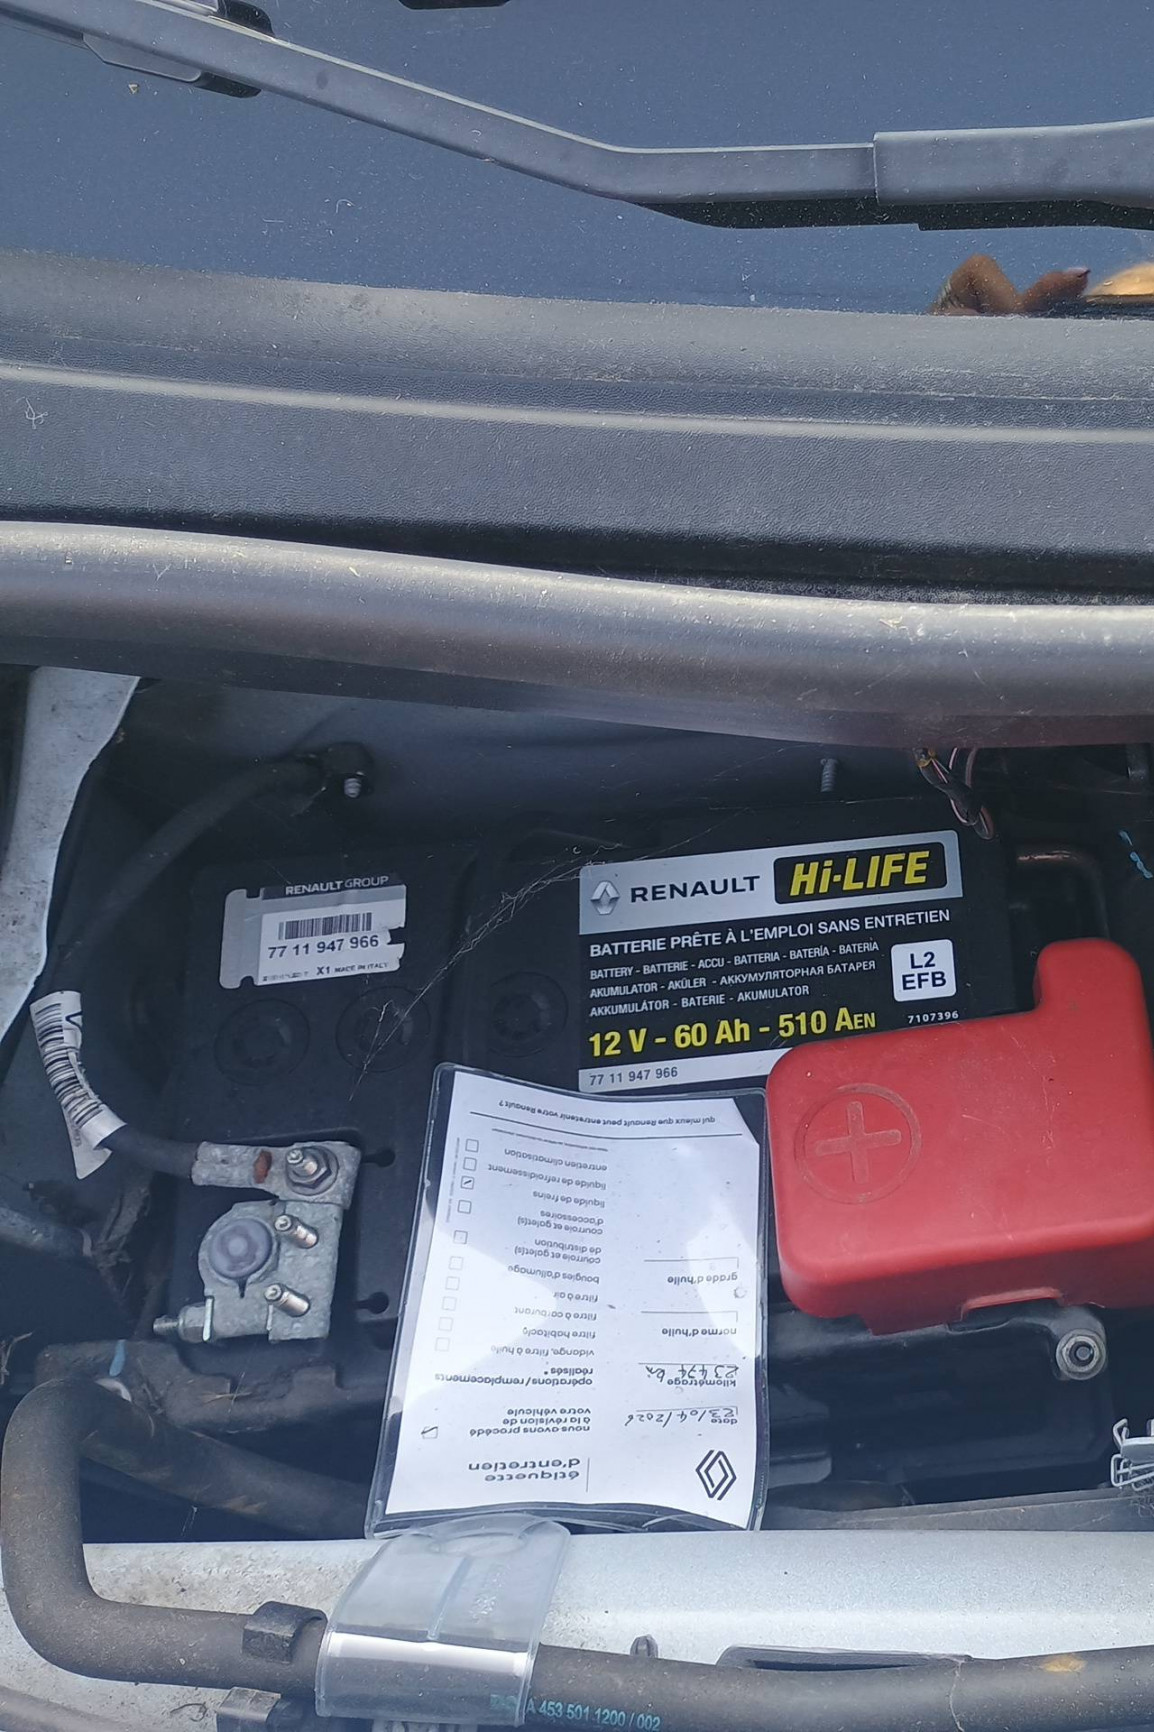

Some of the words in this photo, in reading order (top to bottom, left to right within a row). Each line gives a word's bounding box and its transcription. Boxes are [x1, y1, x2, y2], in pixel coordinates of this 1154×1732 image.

[789, 850, 930, 897] Hi-LIFE
[285, 880, 343, 896] RENAULT
[344, 875, 389, 889] GROUP
[630, 875, 761, 903] RENAULT
[590, 937, 667, 957] BATTERIE
[670, 931, 722, 949] PRÊTE
[725, 928, 737, 944] À
[741, 922, 814, 942] L'EMPLOI
[818, 918, 860, 934] SANS
[864, 908, 950, 930] ENTRETIEN
[268, 945, 288, 959] 77
[292, 943, 310, 956] 11
[316, 938, 344, 954] 947
[350, 935, 379, 949] 966
[590, 966, 634, 980] BATTERY
[643, 961, 688, 975] BATTERIE
[698, 958, 724, 969] ACCU
[734, 952, 780, 966] BATTERIA
[789, 944, 829, 960] BATERÍA
[839, 941, 879, 954] BATERIA
[909, 951, 936, 969] L2
[719, 966, 824, 985] АККУМУЛЯТОРНАЯ
[827, 960, 876, 974] БАТАРЕЯ
[901, 971, 947, 991] EFB
[589, 982, 658, 998] AKUMULATOR
[589, 999, 669, 1017] AKKUMULÁTOR
[681, 994, 725, 1008] BATERIE
[737, 985, 810, 1003] AKUMULATOR
[908, 1010, 959, 1024] 7107396
[588, 1030, 622, 1058] 12
[628, 1028, 647, 1054] V
[674, 1022, 708, 1049] 60
[714, 1018, 751, 1046] Ah
[778, 1011, 827, 1039] 510
[589, 1073, 606, 1086] 77
[609, 1072, 623, 1085] 11
[628, 1069, 652, 1083] 947
[655, 1066, 679, 1080] 966
[505, 1102, 536, 1114] Renault
[537, 1108, 558, 1117] votre
[560, 1113, 601, 1125] entretenir
[603, 1118, 622, 1126] peut
[623, 1119, 656, 1127] Renault
[658, 1117, 674, 1125] que
[702, 1116, 715, 1125] qui
[504, 1148, 563, 1166] climatisation
[564, 1160, 607, 1171] entretien
[488, 1164, 560, 1184] refroidissement
[562, 1178, 573, 1186] de
[575, 1179, 606, 1190] liquide
[533, 1191, 559, 1203] freins
[560, 1196, 572, 1204] de
[573, 1197, 605, 1208] liquide
[517, 1216, 552, 1229] galet(s)
[540, 1210, 604, 1225] d'accessoires
[553, 1222, 562, 1230] et
[564, 1224, 603, 1235] courroie
[534, 1239, 587, 1253] distribution
[589, 1247, 601, 1255] de
[514, 1246, 549, 1258] galet(s)
[550, 1251, 560, 1259] et
[562, 1253, 600, 1264] courroie
[507, 1265, 560, 1279] d'allumage
[706, 1272, 738, 1283] grade
[562, 1272, 599, 1284] bougies
[667, 1275, 704, 1285] d'huile
[553, 1291, 565, 1299] air
[567, 1293, 573, 1301] à
[575, 1293, 598, 1302] filtre
[514, 1306, 563, 1318] carburant
[565, 1312, 571, 1320] à
[573, 1312, 597, 1321] filtre
[572, 1331, 596, 1339] filtre
[662, 1328, 699, 1337] d'huile
[701, 1327, 736, 1336] norme
[525, 1348, 549, 1356] filtre
[551, 1347, 594, 1357] vidange,
[714, 1365, 738, 1378] 23
[667, 1377, 736, 1387] kilométrage
[507, 1408, 557, 1417] véhicule
[502, 1418, 517, 1426] de
[520, 1418, 567, 1426] révision
[570, 1417, 580, 1425] la
[583, 1417, 590, 1425] à
[470, 1426, 520, 1437] procédé
[523, 1427, 560, 1435] avons
[562, 1425, 590, 1433] nous
[468, 1458, 580, 1471] d'entretien
[485, 1470, 580, 1482] étiquette
[539, 1700, 563, 1718] 453
[566, 1703, 590, 1721] 501
[594, 1707, 626, 1727] 1200
[637, 1714, 661, 1732] 002
